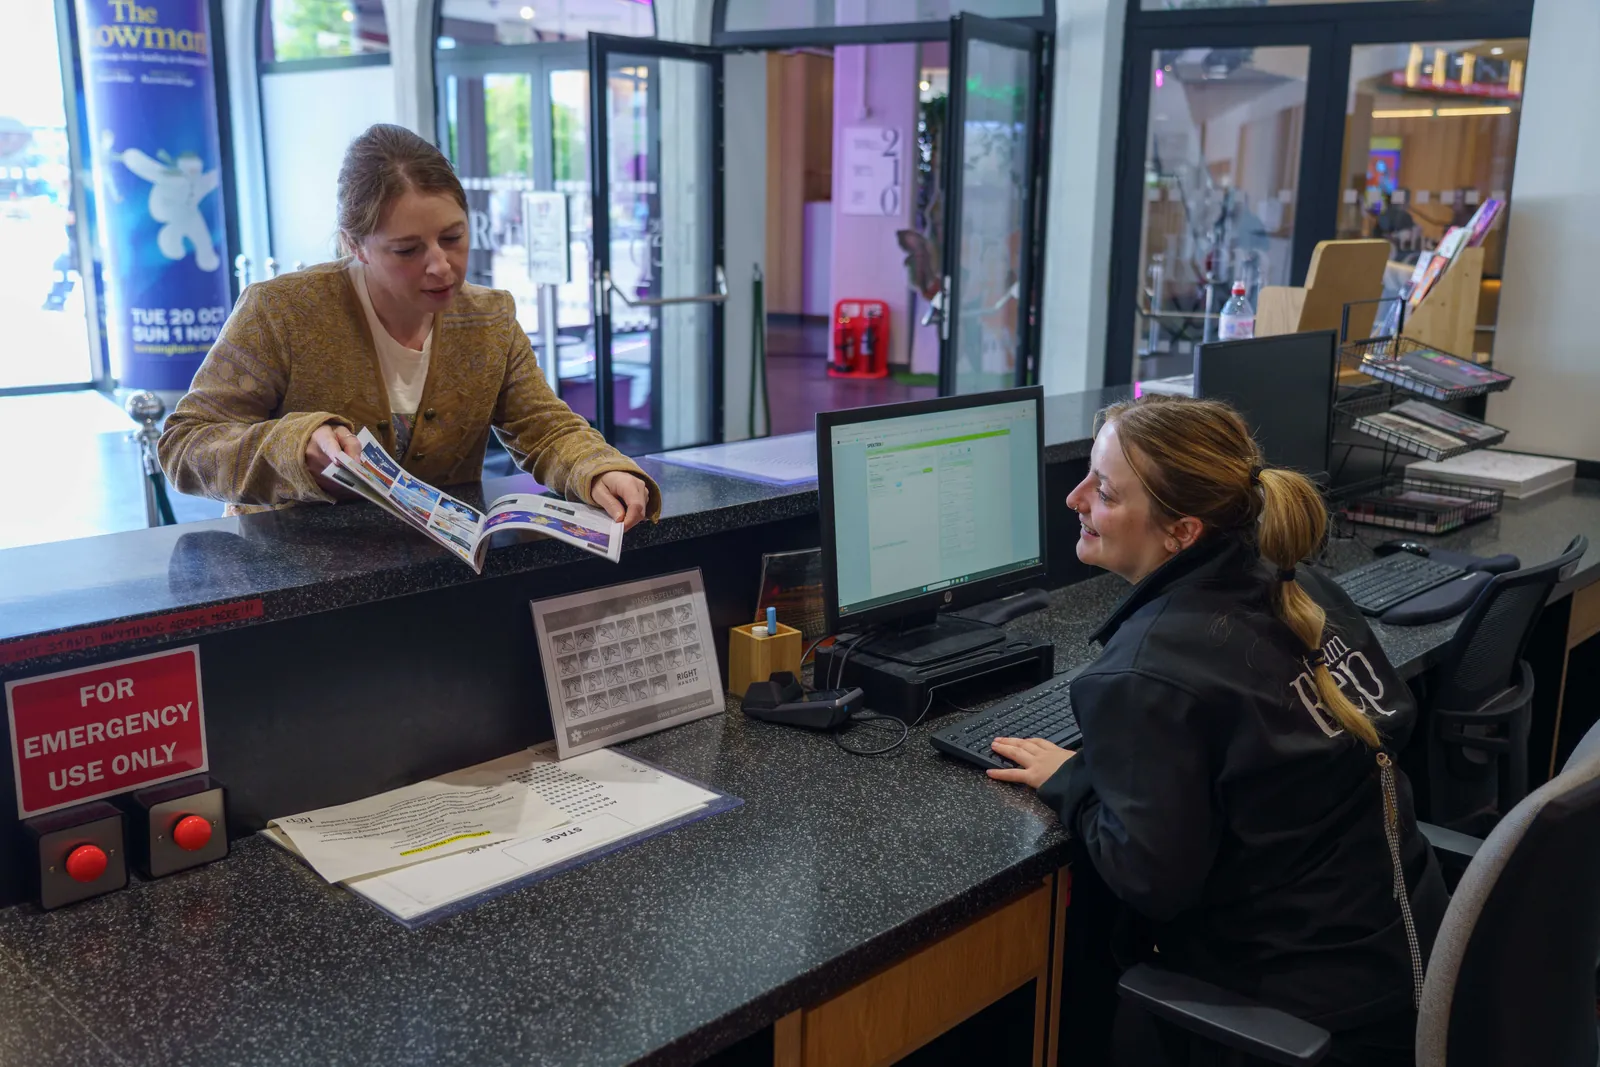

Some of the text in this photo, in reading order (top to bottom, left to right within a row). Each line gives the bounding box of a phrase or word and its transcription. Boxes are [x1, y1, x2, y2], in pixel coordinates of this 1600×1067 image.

[109, 0, 158, 24] The
[88, 24, 208, 55] owman
[131, 307, 167, 326] TUE
[169, 308, 196, 326] 20
[132, 325, 220, 342] SUN 1 NOV
[632, 587, 686, 606] INGERSPELLING
[50, 633, 95, 652] STAND
[101, 621, 165, 642] ANYTHING
[1302, 635, 1352, 677] tam
[676, 668, 698, 682] RIGHT
[79, 677, 135, 708] FOR
[22, 701, 193, 760] EMERGENCY
[48, 742, 177, 792] USE ONLY
[541, 826, 583, 844] STAGE
